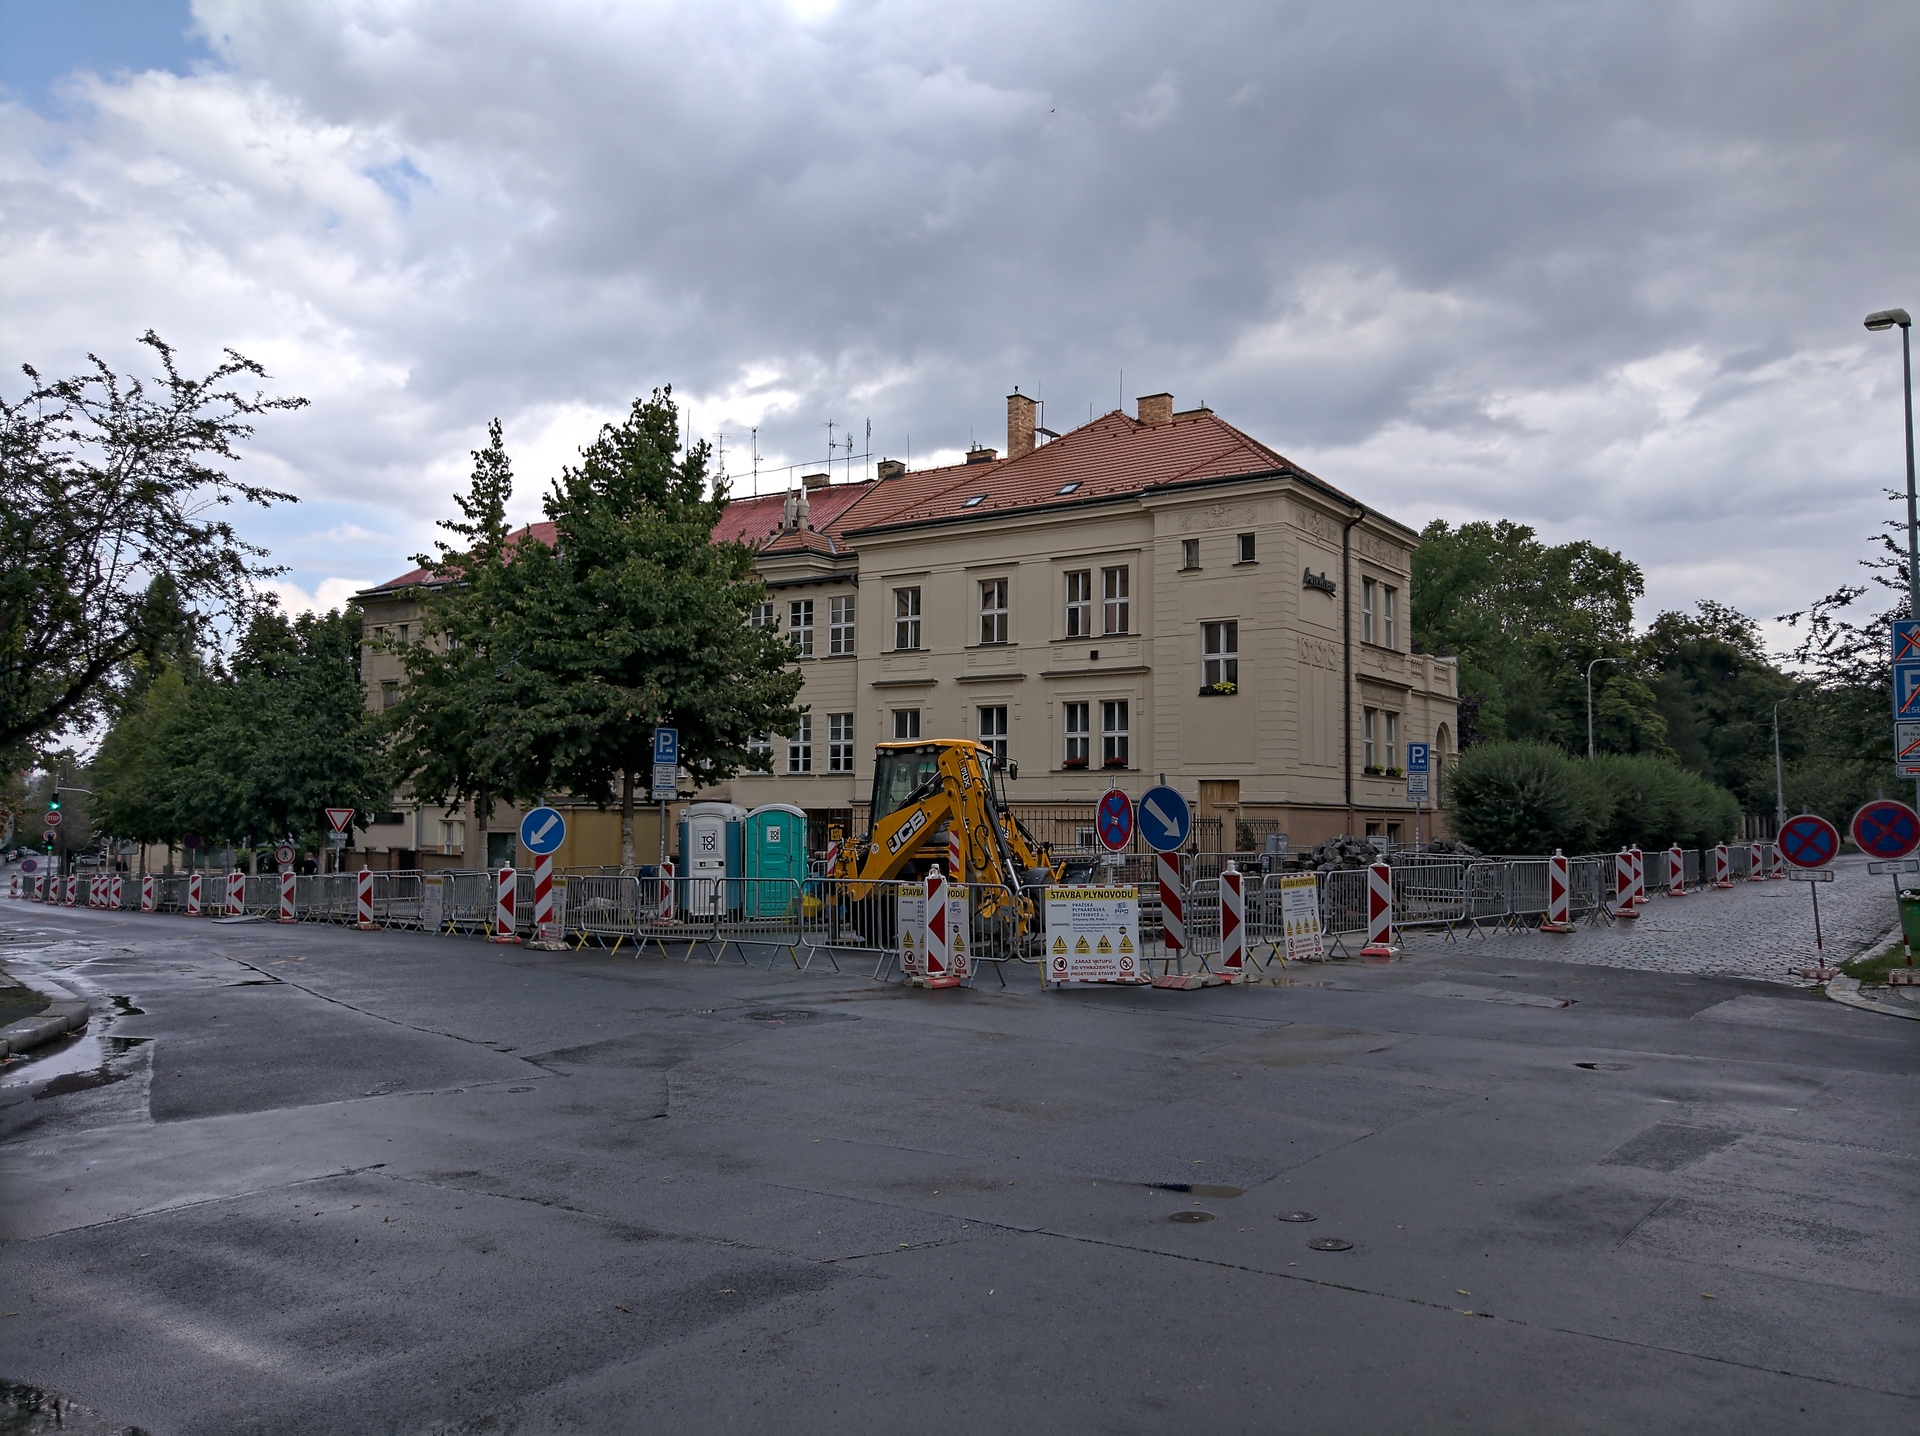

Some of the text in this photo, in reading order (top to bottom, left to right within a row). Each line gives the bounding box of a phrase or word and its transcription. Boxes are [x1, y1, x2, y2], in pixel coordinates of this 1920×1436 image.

[660, 732, 673, 753] P
[1412, 746, 1425, 764] P
[890, 810, 926, 853] JCB
[902, 888, 924, 896] STAVBA
[1051, 891, 1133, 899] STAVBA PLYNOVODU
